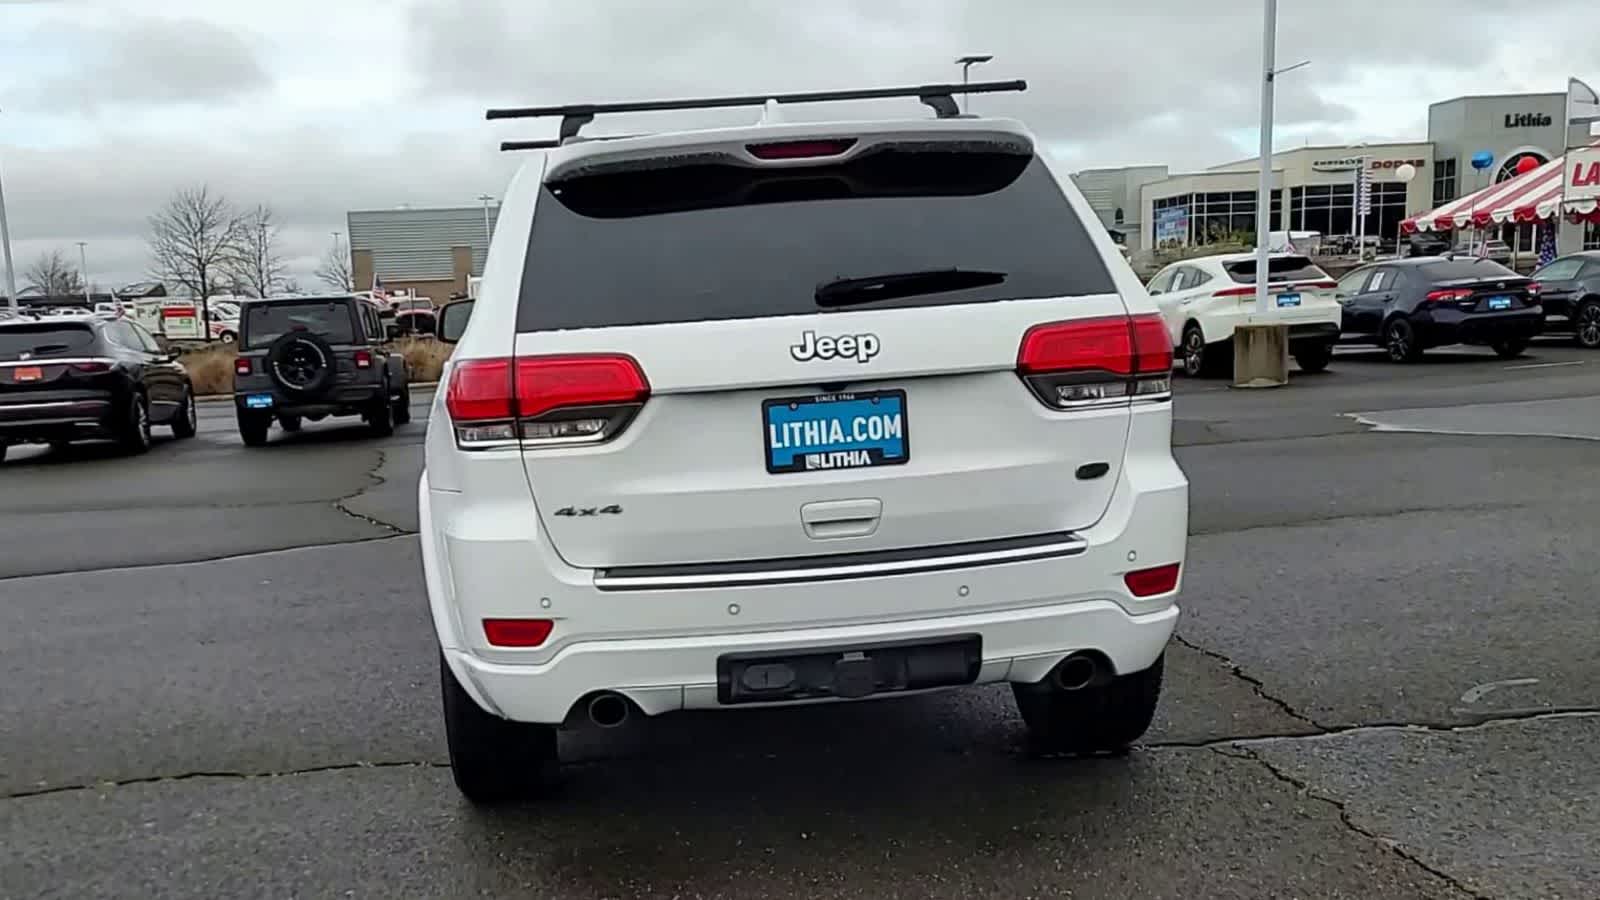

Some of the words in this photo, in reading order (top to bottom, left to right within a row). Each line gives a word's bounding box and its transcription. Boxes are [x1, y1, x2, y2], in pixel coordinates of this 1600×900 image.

[1504, 112, 1552, 128] Lithia
[790, 330, 881, 364] Jeep
[769, 413, 902, 449] LITHIA.COM
[820, 450, 872, 468] LITHIA
